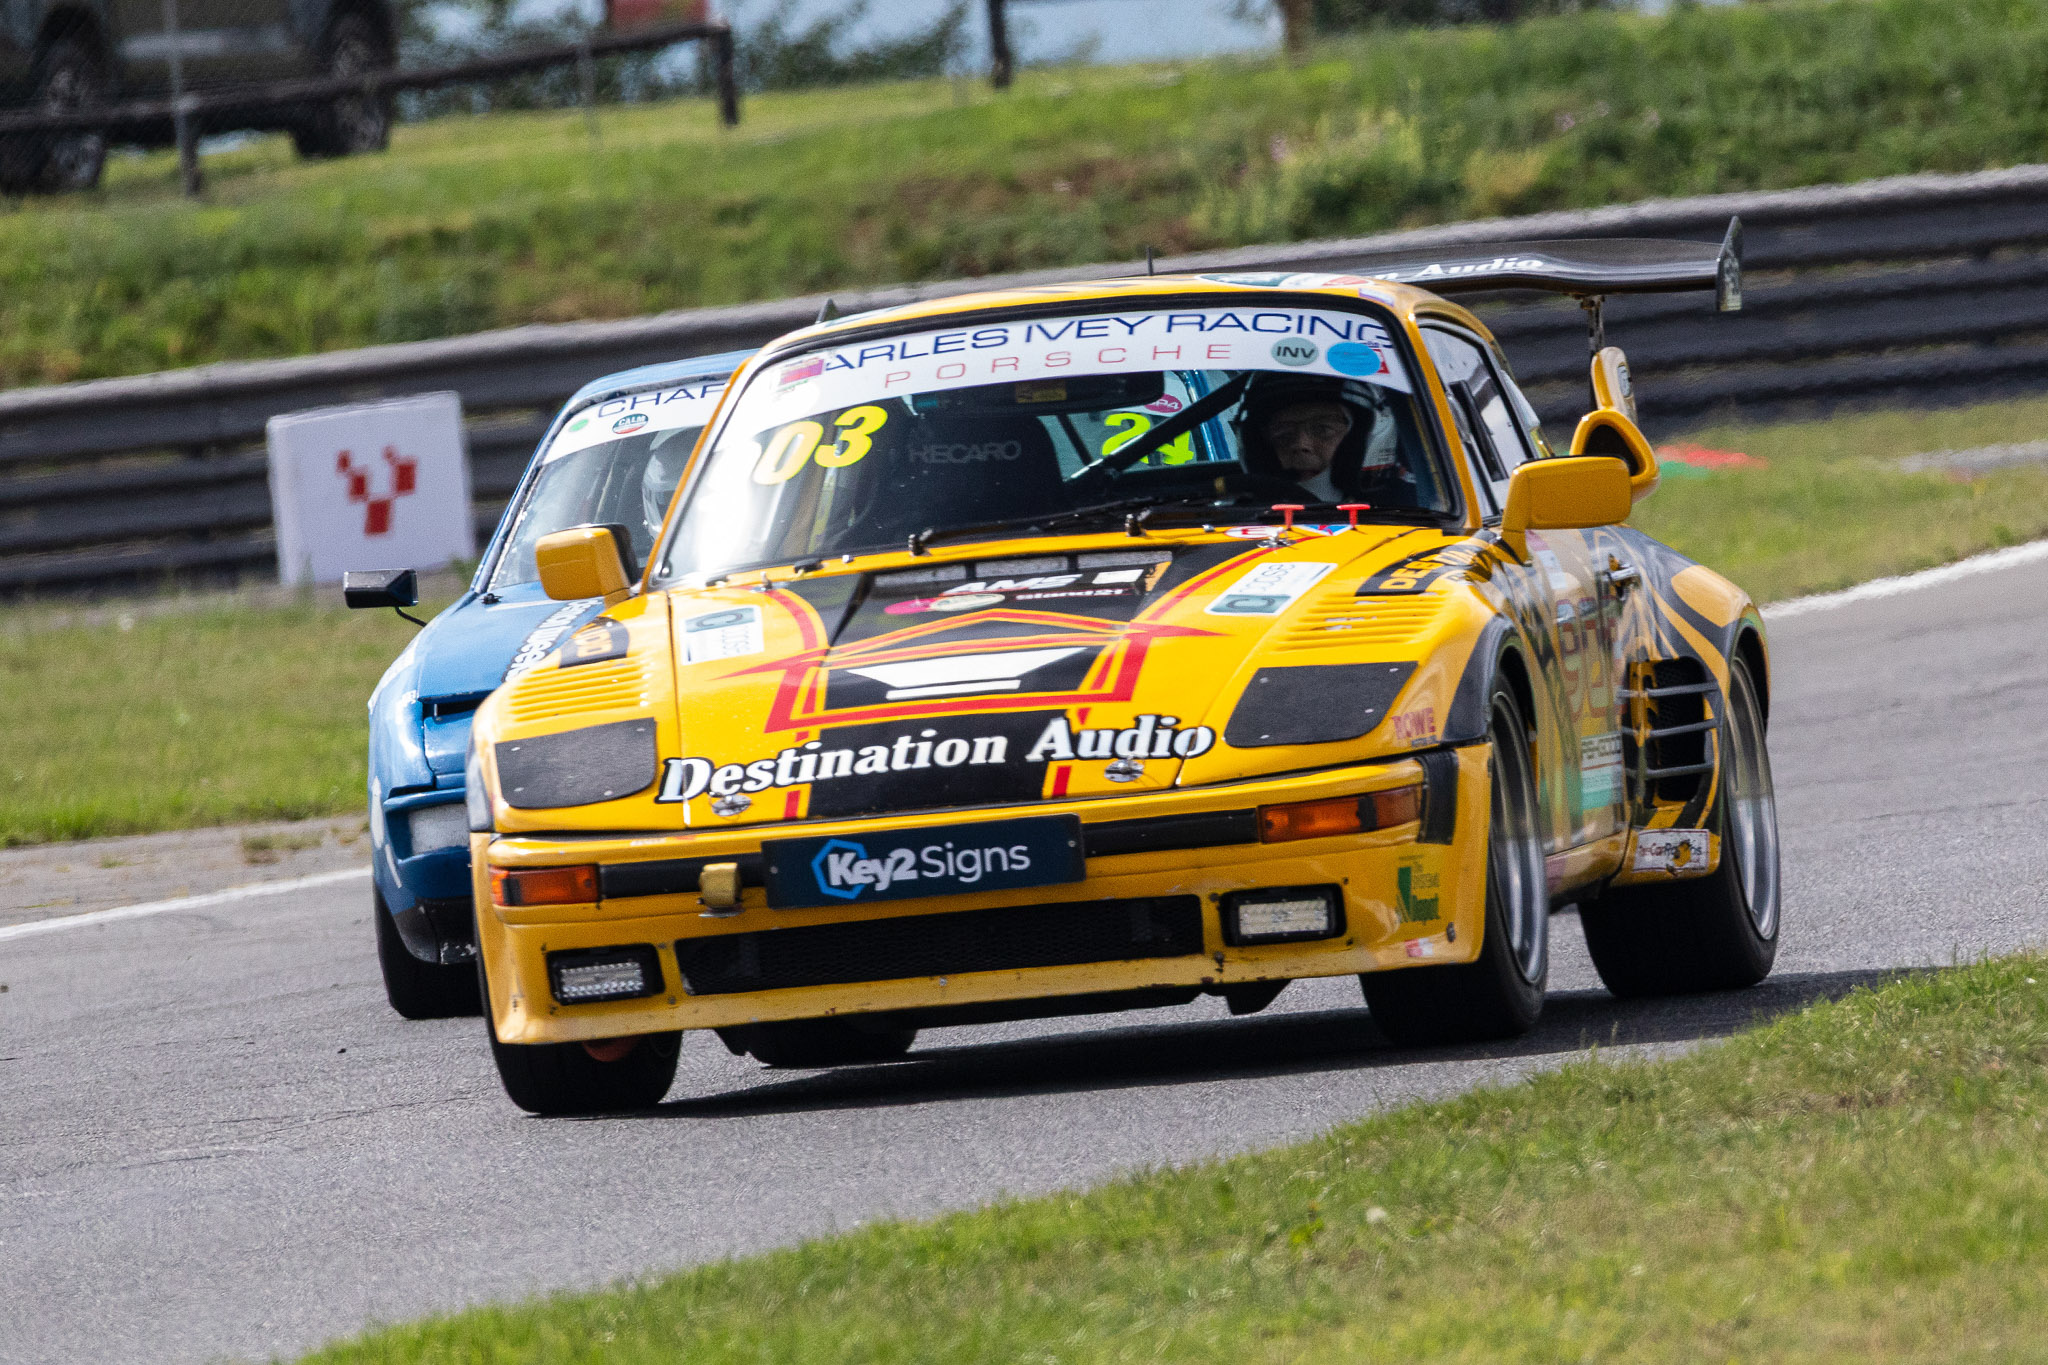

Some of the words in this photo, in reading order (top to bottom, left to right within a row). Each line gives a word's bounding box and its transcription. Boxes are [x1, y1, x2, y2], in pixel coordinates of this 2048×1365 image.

[1420, 257, 1545, 276] Audio
[826, 328, 1009, 371] ARLES
[1025, 314, 1155, 342] IVEY
[884, 342, 1232, 389] PORSCHE
[1276, 346, 1316, 359] INV
[657, 728, 1009, 804] Destination
[1024, 714, 1214, 764] Audio
